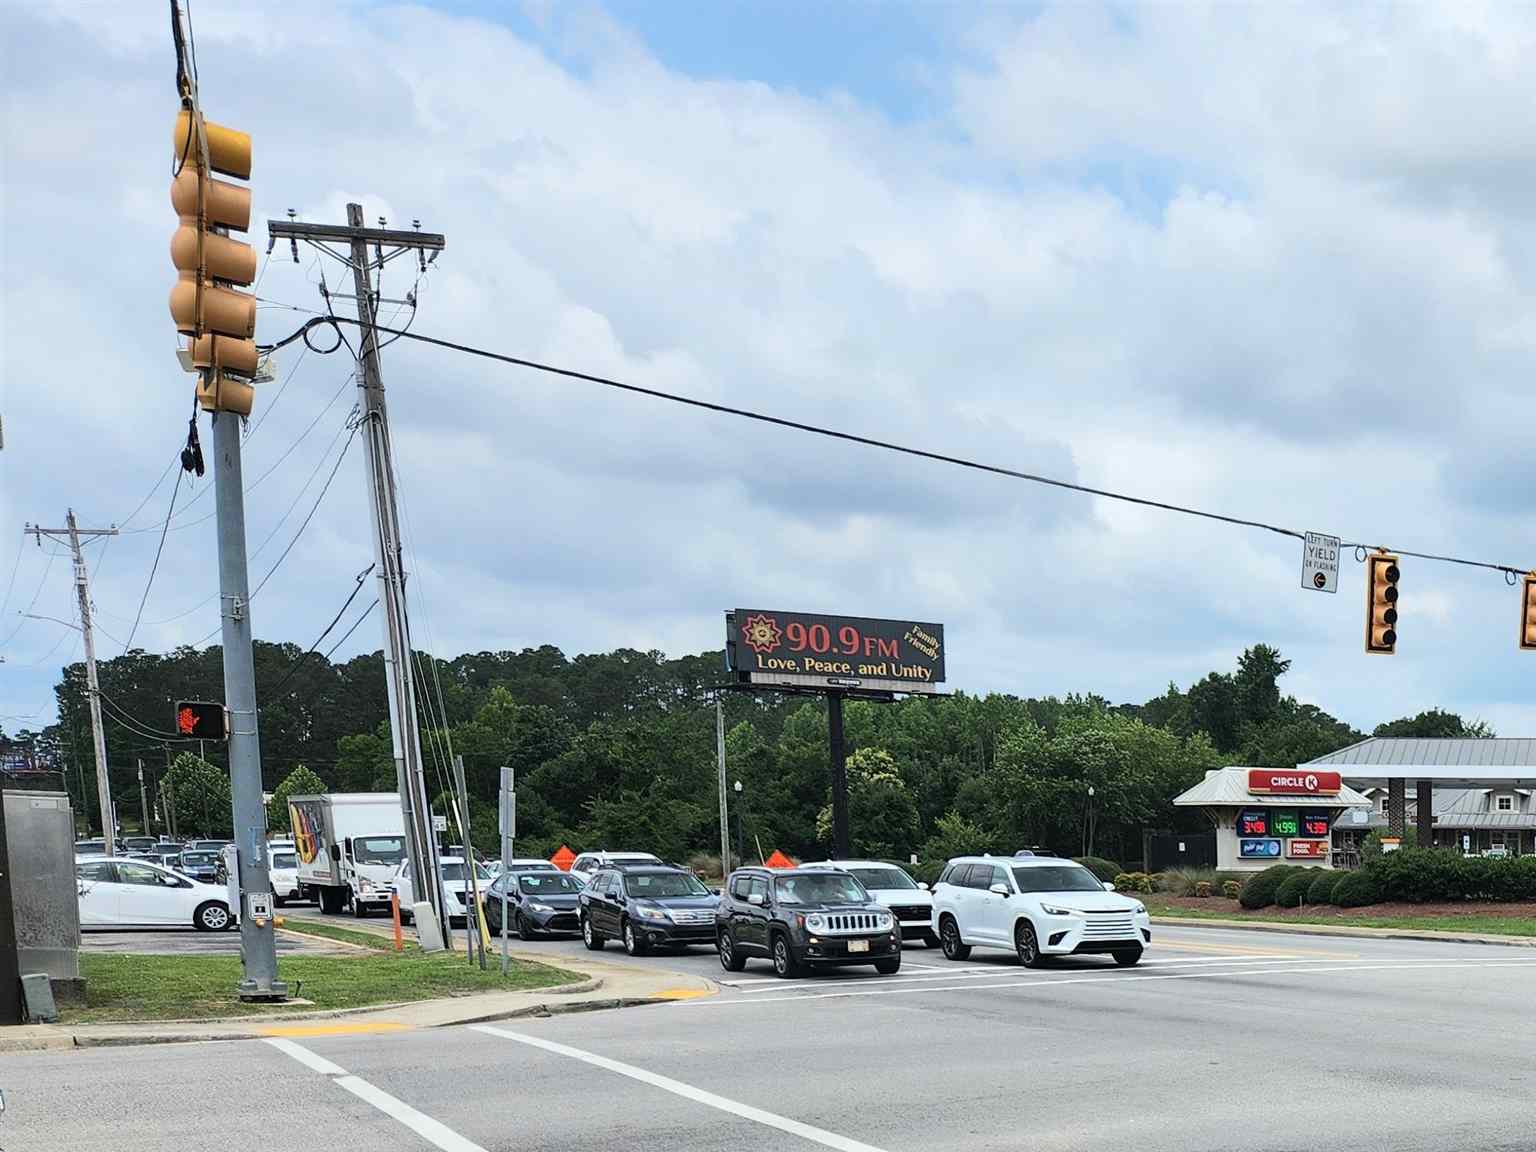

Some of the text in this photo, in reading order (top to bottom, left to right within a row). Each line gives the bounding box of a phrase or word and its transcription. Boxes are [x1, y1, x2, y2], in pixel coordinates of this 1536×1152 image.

[1308, 546, 1336, 561] YIELD
[786, 622, 900, 659] 90.9 FM
[903, 631, 940, 661] Friendly
[912, 623, 941, 649] Family
[757, 654, 932, 682] Love, Peace, and Unity
[1270, 776, 1305, 787] CIRCLE
